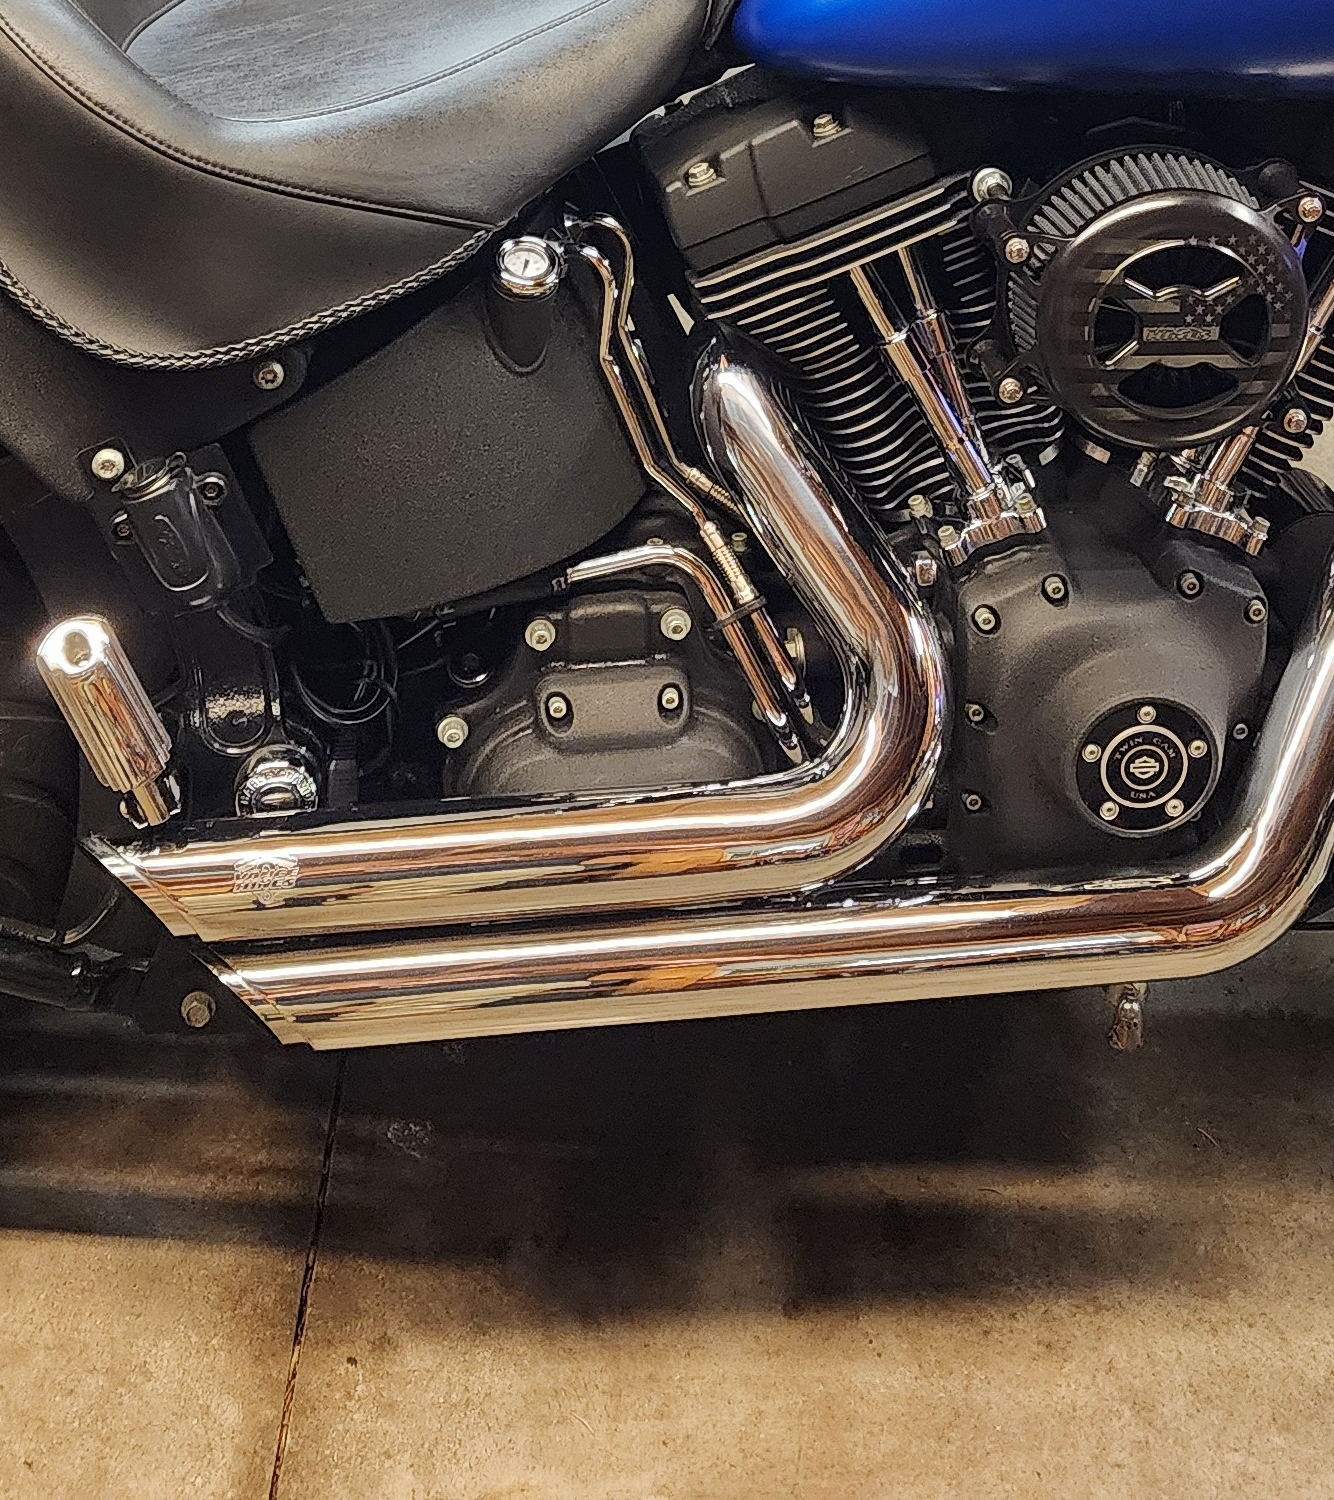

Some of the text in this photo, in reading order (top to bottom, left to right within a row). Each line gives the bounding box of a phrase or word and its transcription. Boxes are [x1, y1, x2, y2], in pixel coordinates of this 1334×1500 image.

[1113, 736, 1177, 760] TWIN CAM
[1129, 790, 1157, 800] USA
